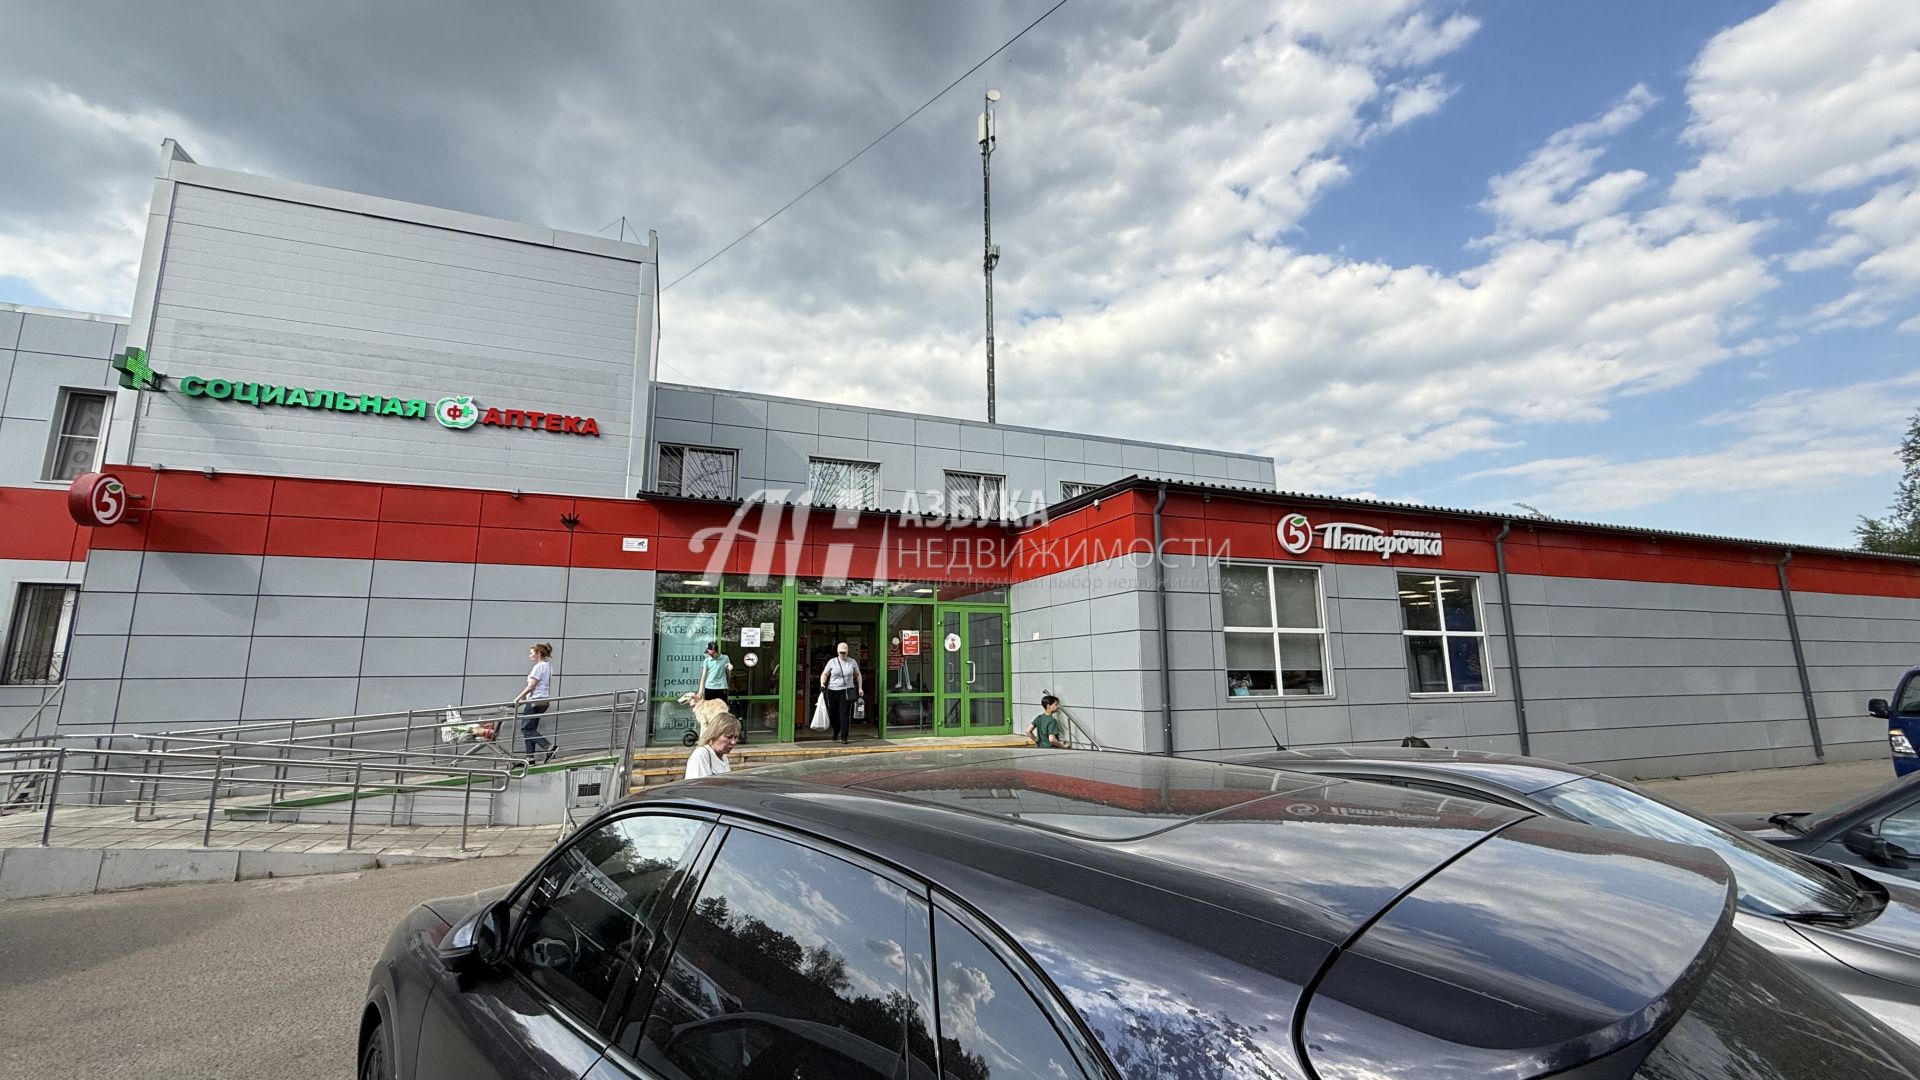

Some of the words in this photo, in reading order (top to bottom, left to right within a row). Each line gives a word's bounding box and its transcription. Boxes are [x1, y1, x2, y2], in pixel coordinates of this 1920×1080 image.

[180, 375, 427, 419] СОЦИАЛЬНАЯ
[483, 407, 600, 436] АПТЕКА
[1315, 522, 1443, 560] Пятерочка
[664, 625, 708, 634] АТЕЛЬЕ
[666, 654, 705, 662] пошив
[681, 666, 689, 674] и
[663, 678, 700, 687] ремон
